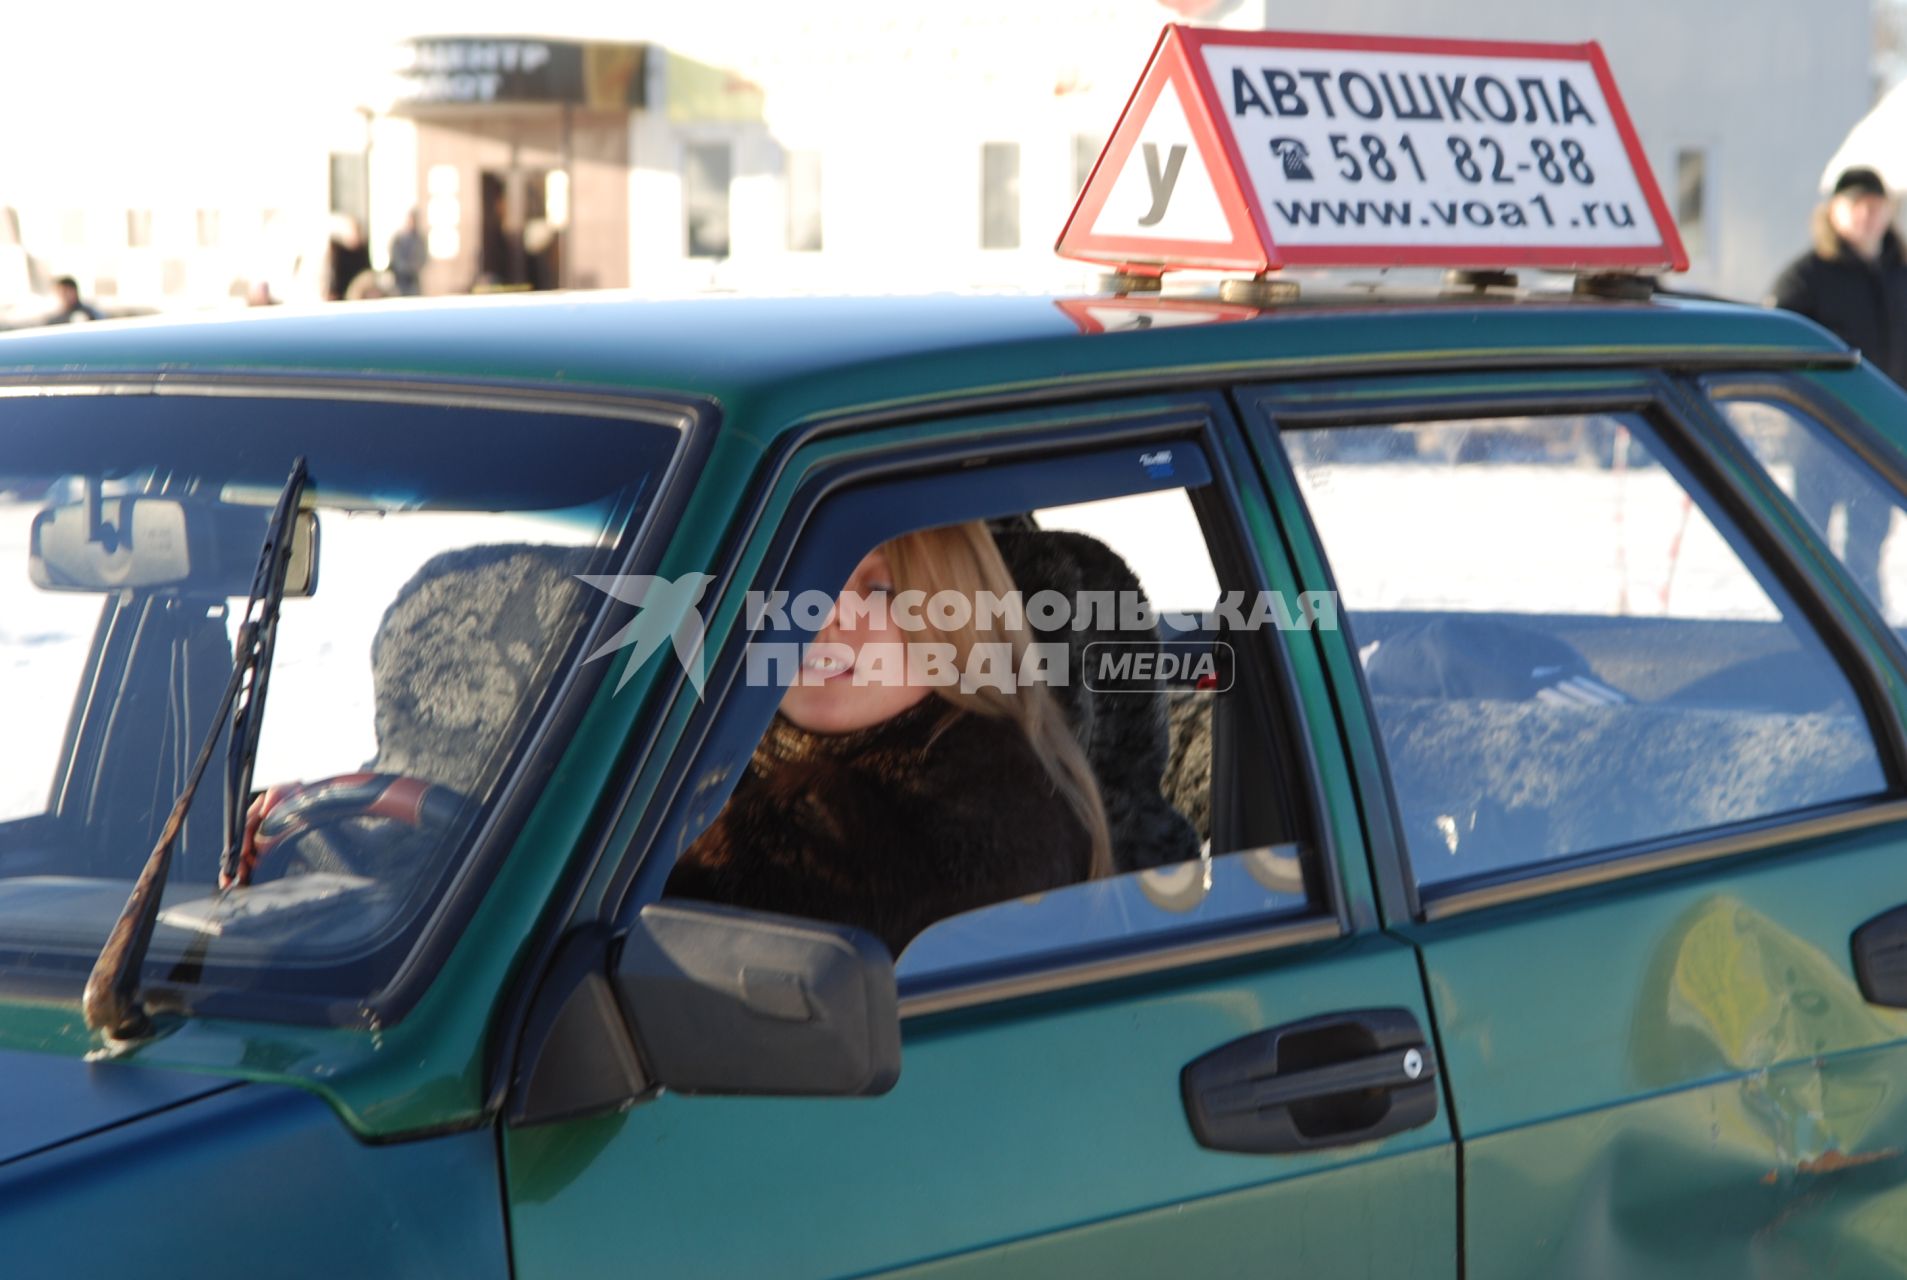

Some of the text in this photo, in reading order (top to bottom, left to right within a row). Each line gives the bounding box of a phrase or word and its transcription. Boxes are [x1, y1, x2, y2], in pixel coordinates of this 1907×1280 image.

[1231, 66, 1597, 125] АВТОШКОЛА
[1327, 133, 1596, 185] 581 82-88
[1273, 194, 1636, 228] www.voa1.ru
